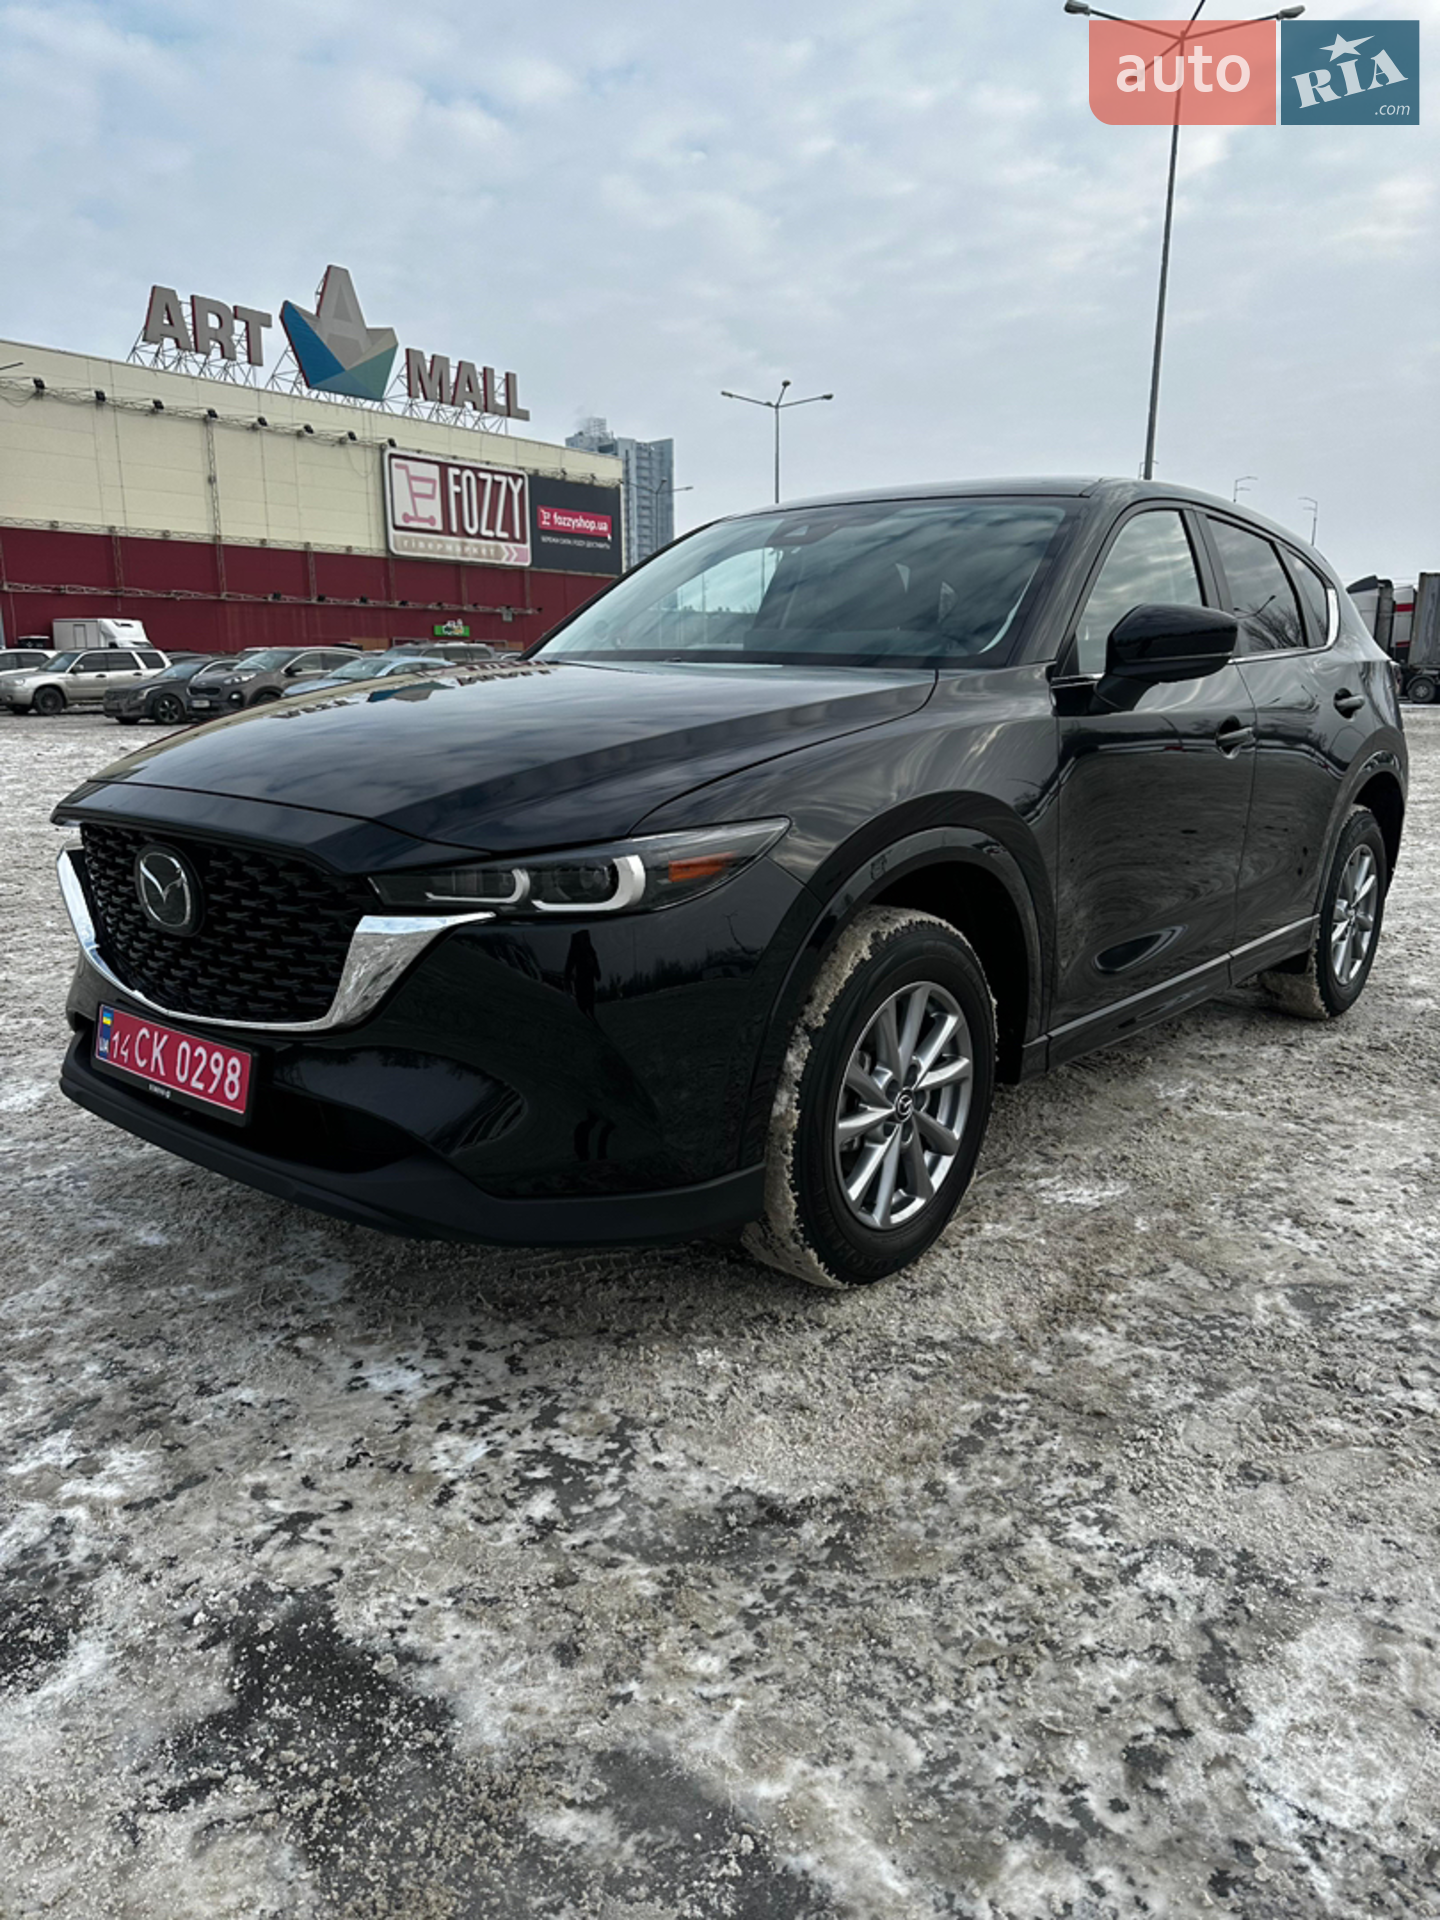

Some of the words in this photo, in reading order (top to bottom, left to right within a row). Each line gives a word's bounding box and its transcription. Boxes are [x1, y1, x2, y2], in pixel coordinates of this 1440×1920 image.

[143, 285, 272, 366] ART
[405, 348, 530, 421] MALL
[448, 467, 523, 540] FOZZY
[553, 512, 609, 532] fozzyshop.ua
[176, 1041, 242, 1101] 0298
